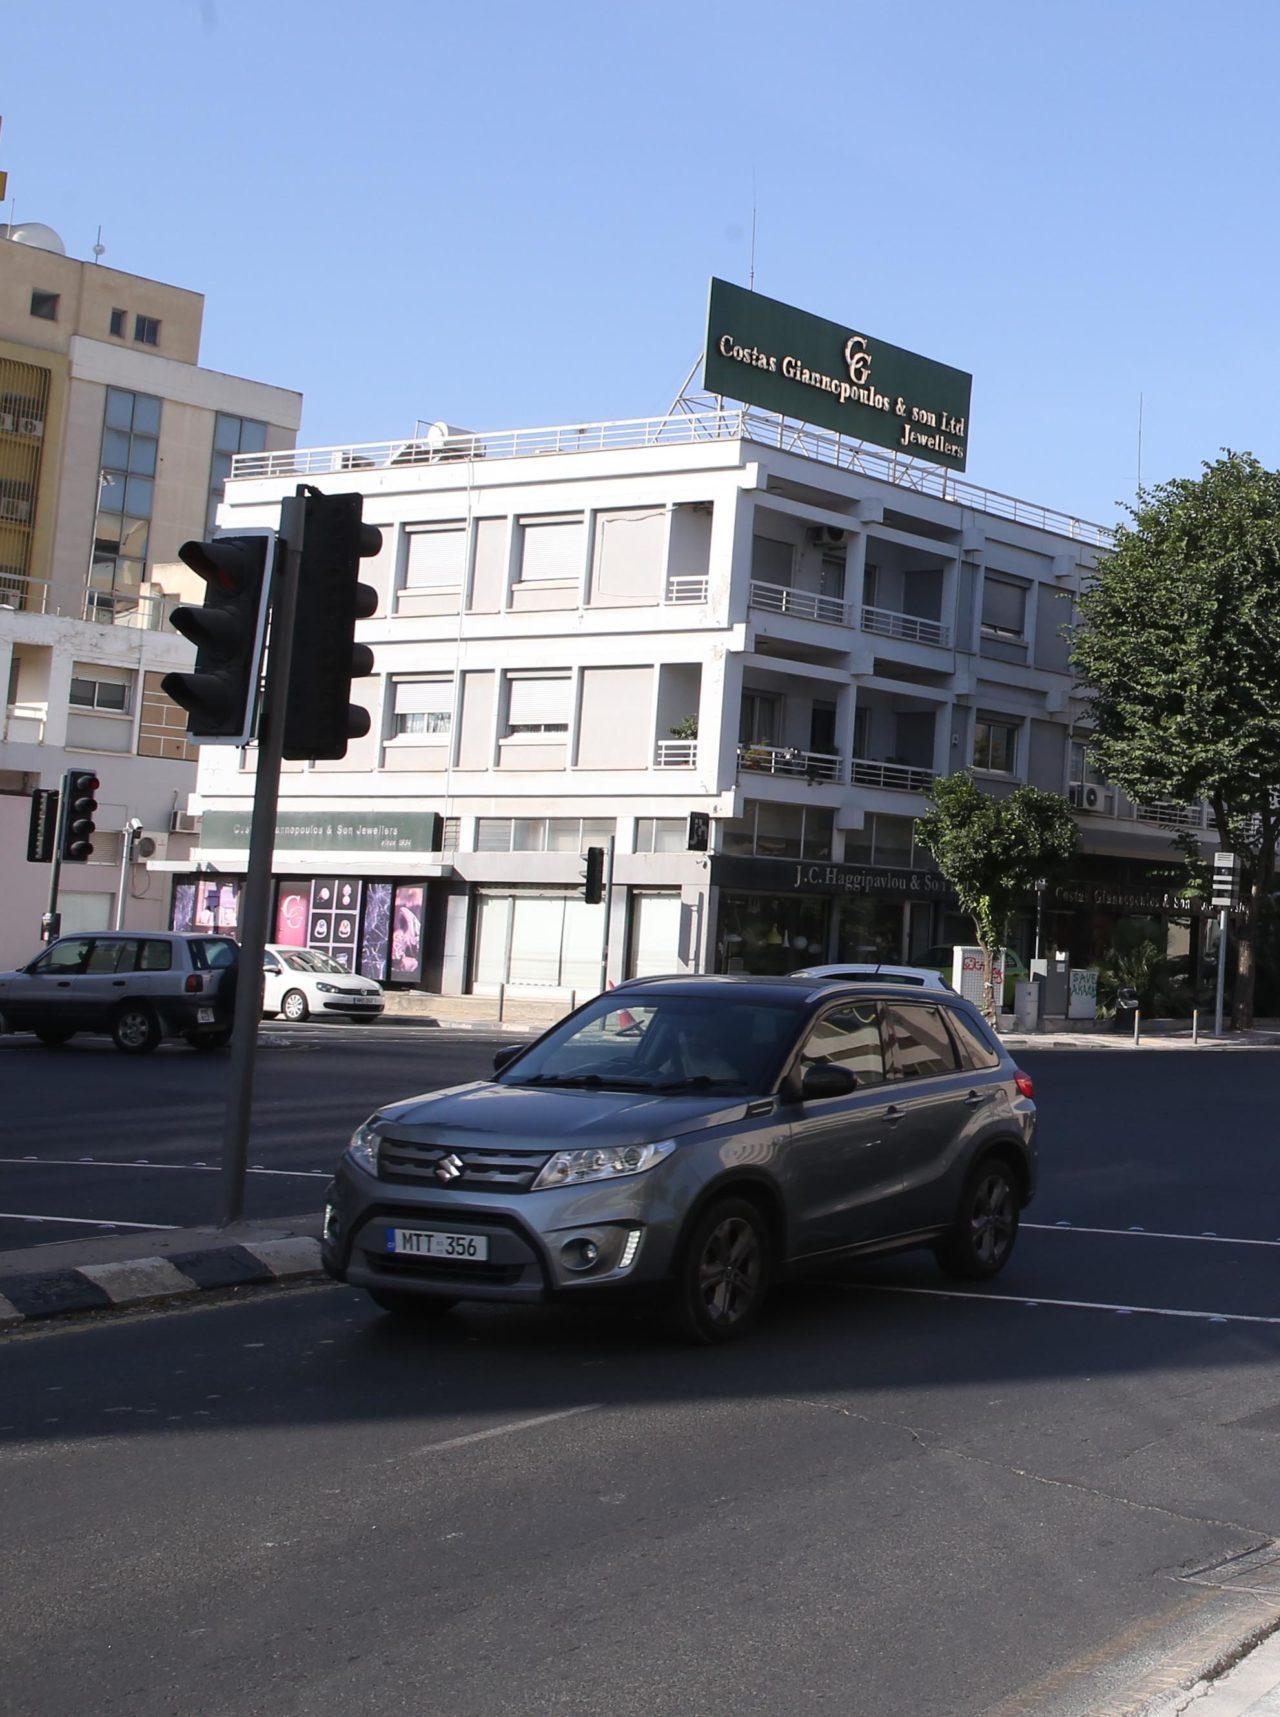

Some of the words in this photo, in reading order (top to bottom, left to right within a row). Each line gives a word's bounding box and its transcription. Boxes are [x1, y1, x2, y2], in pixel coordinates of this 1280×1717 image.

[719, 334, 777, 372] Costas
[782, 356, 890, 413] Giannopoulos
[895, 397, 907, 417] &
[911, 405, 936, 428] son
[941, 411, 965, 437] Ltd
[900, 424, 965, 459] Jewellers
[356, 824, 399, 836] Jewellers
[910, 875, 920, 890] &
[1072, 972, 1097, 985] SAVE
[402, 1231, 435, 1254] MTT
[445, 1235, 478, 1257] 356
